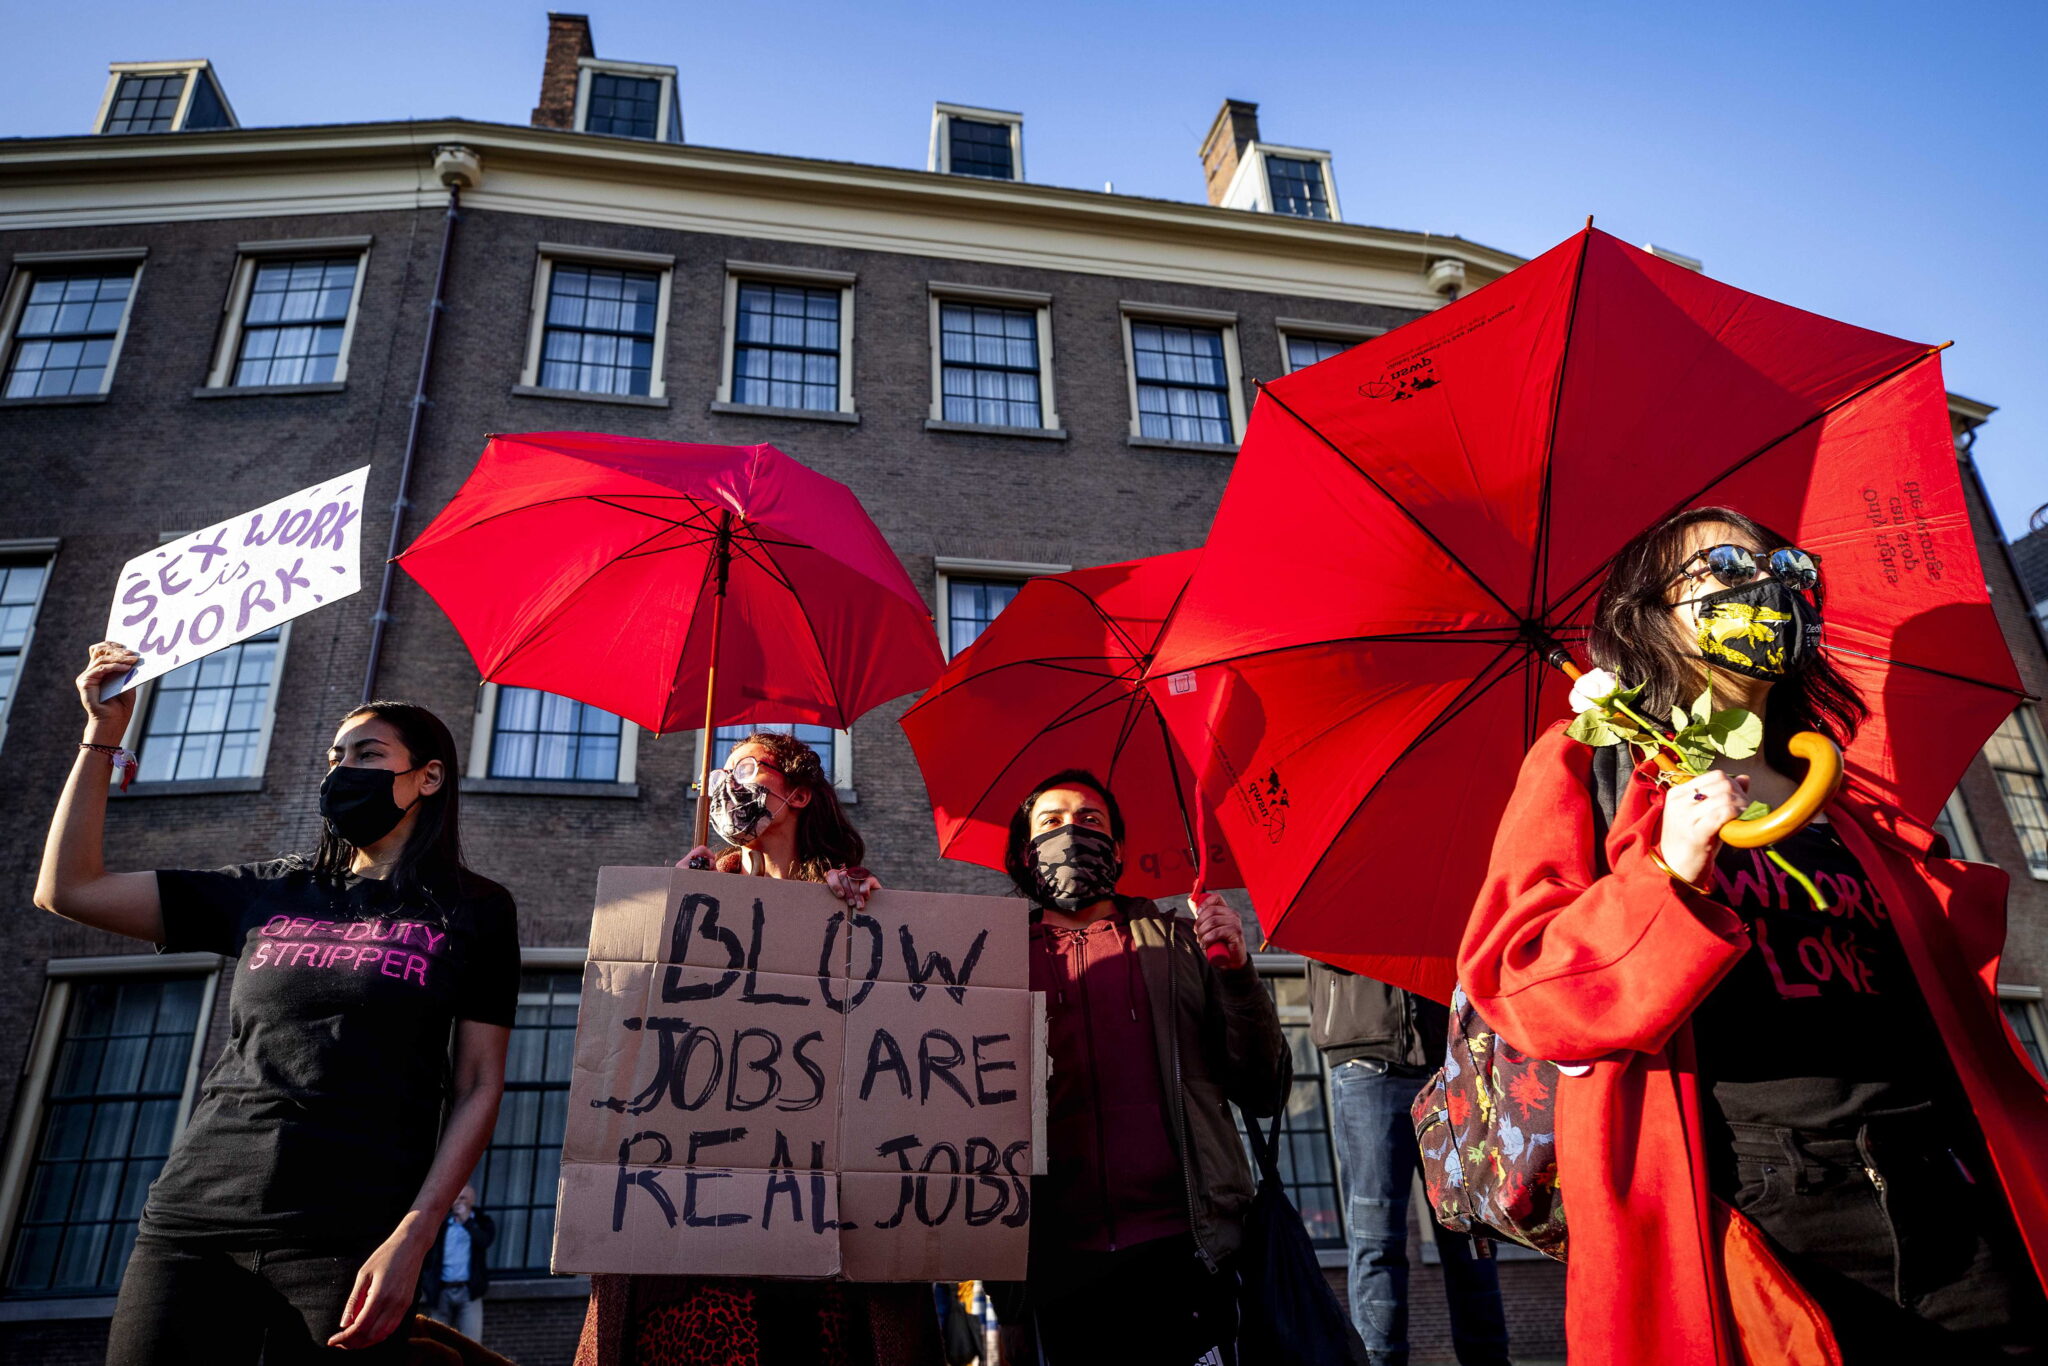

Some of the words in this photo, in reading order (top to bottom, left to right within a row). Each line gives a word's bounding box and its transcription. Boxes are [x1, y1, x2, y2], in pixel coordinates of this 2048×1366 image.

[122, 528, 228, 627] SEX
[243, 501, 359, 551] WORK
[194, 560, 250, 596] is
[250, 943, 428, 986] STRIPPER
[261, 914, 445, 951] OFF-DUTY
[662, 893, 990, 1014] BLOW
[1755, 918, 1882, 999] LOVE
[590, 1016, 826, 1116] JOBS
[859, 1028, 1017, 1108] ARE
[612, 1126, 858, 1233] REAL
[873, 1134, 1031, 1230] JOBS
